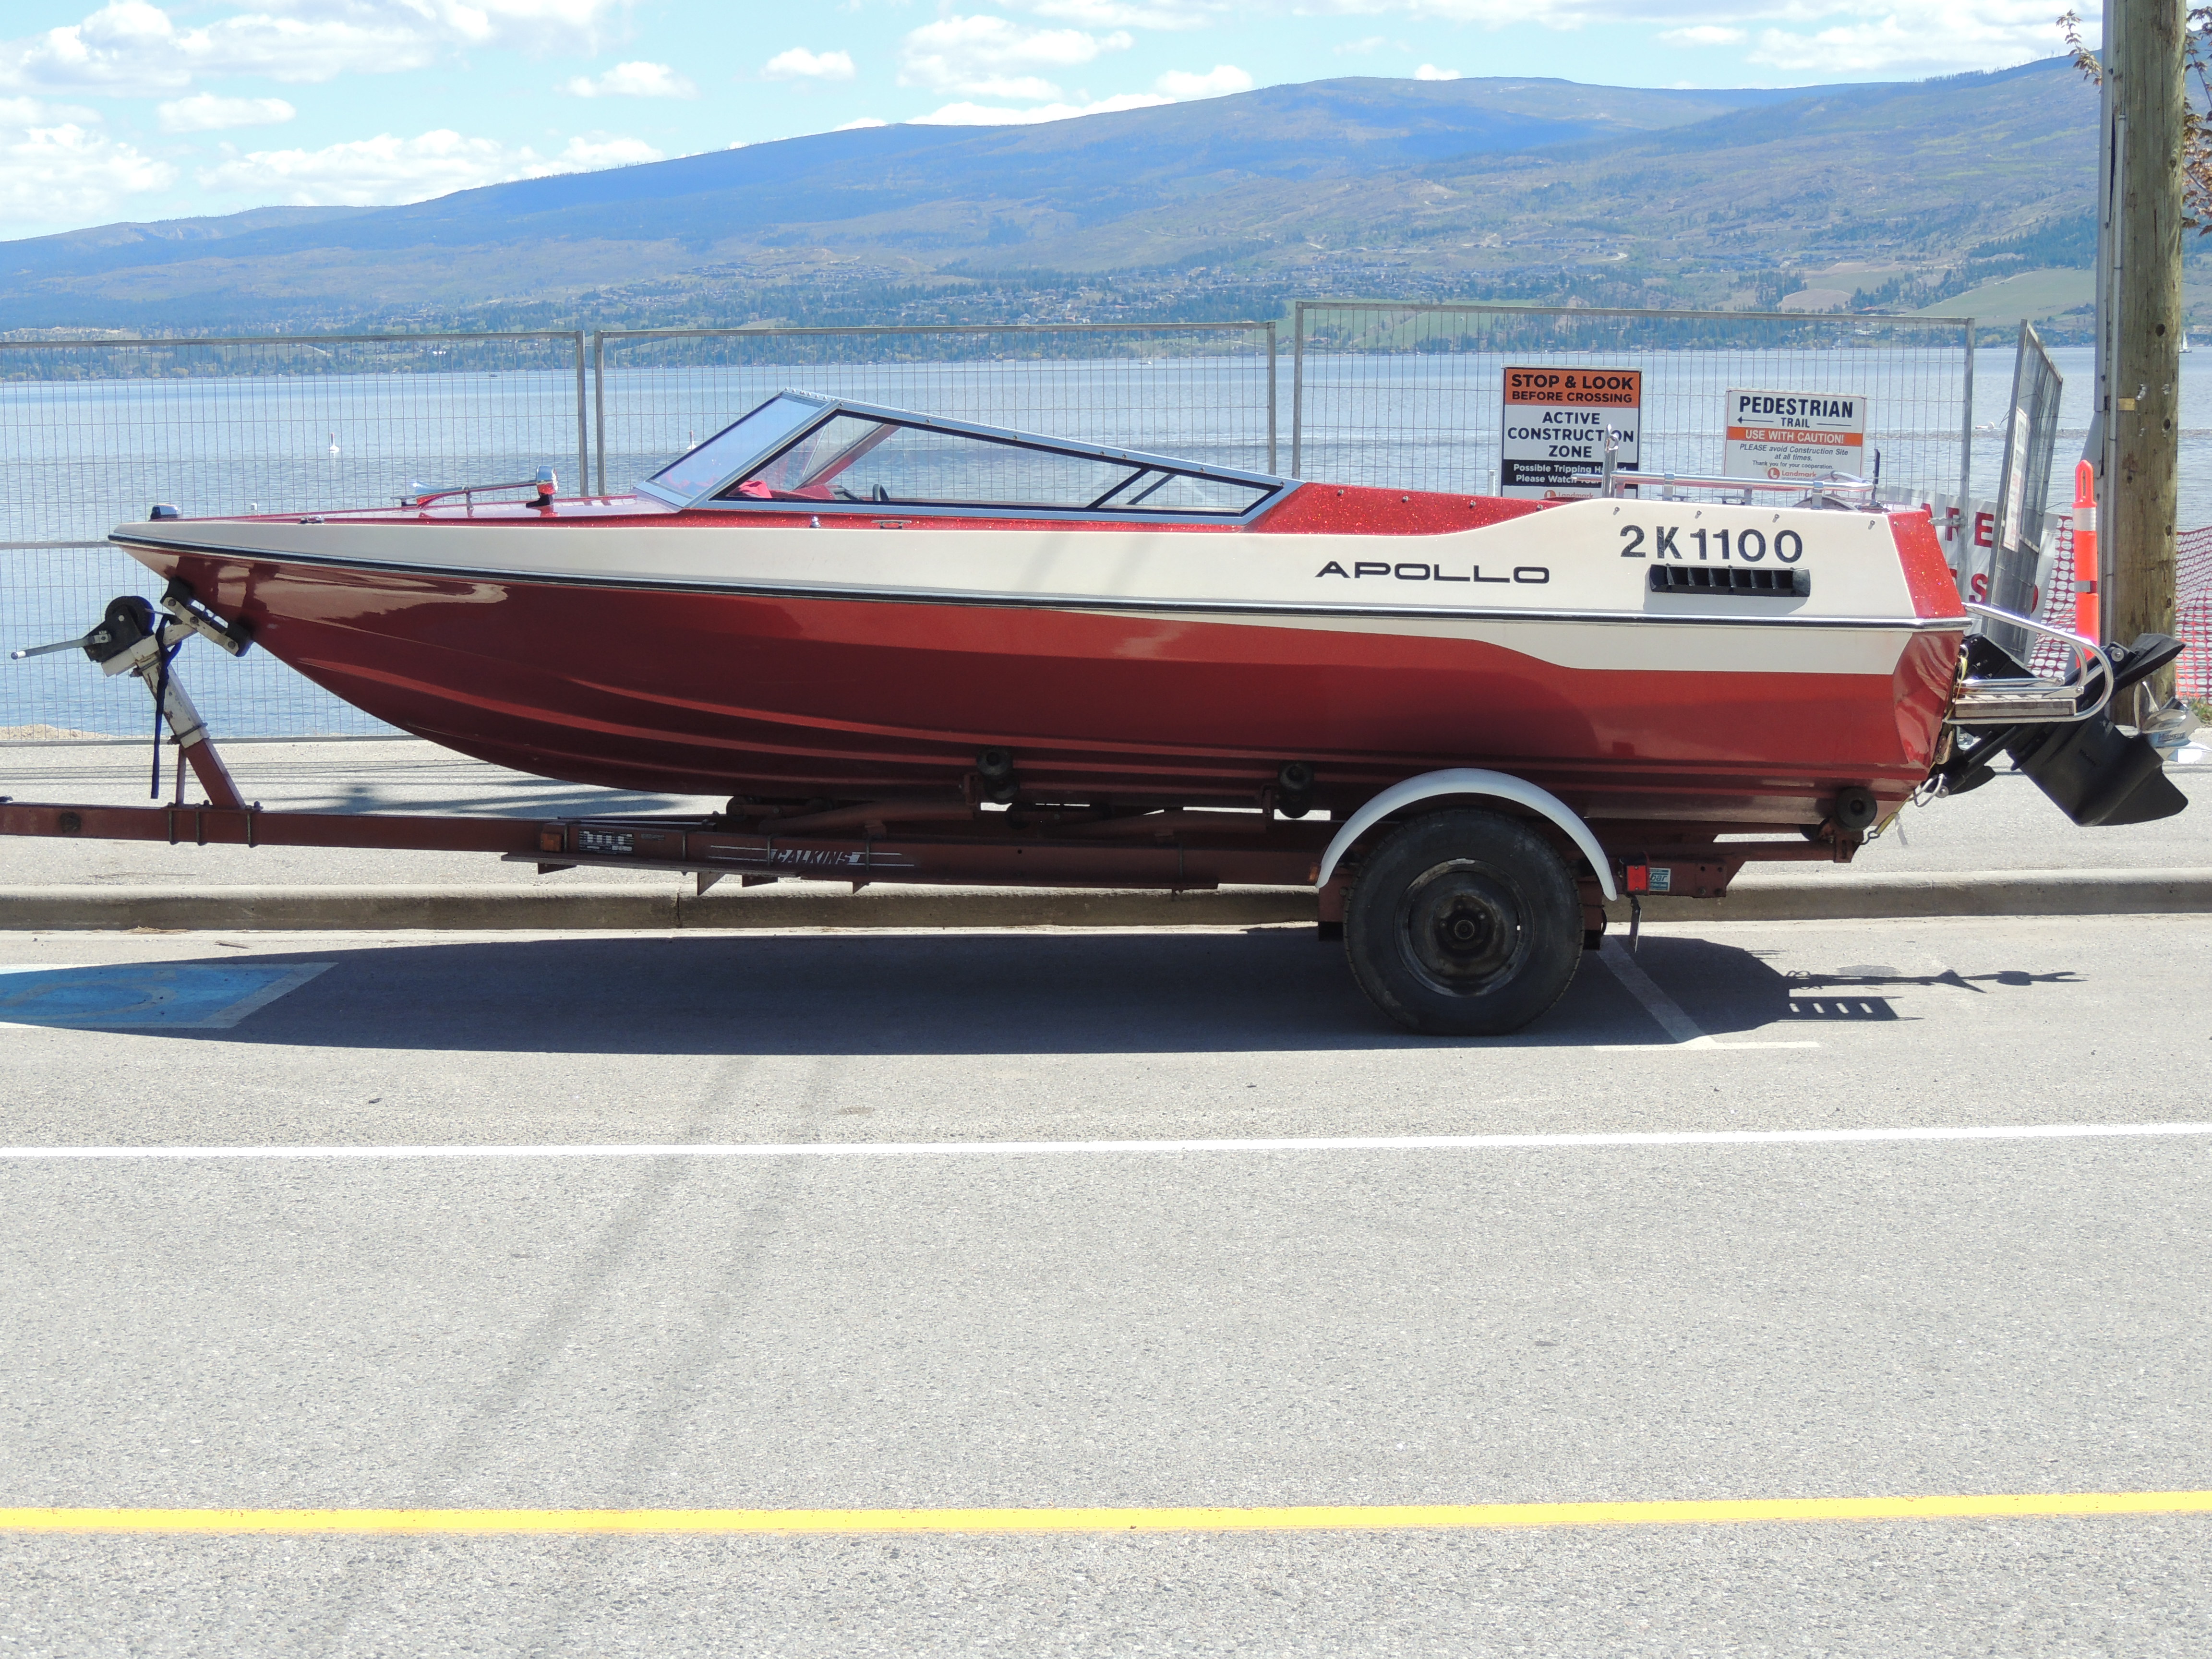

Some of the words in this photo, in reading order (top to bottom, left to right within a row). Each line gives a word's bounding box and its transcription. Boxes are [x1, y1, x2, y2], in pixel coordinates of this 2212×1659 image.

[1512, 374, 1560, 388] STOP
[1564, 375, 1576, 388] &
[1582, 376, 1634, 390] LOOK
[1512, 391, 1563, 401] BEFORE
[1566, 392, 1632, 403] CROSSING
[1739, 396, 1853, 418] PEDESTRIAN
[1542, 411, 1600, 425] ACTIVE
[1780, 417, 1810, 428] TRAIL
[1507, 427, 1634, 442] CONSTRUCTON
[1745, 430, 1765, 439] USE
[1768, 431, 1794, 441] WITH
[1797, 432, 1844, 444] CAUTION!
[1548, 445, 1592, 458] ZONE
[1739, 443, 1767, 452] PLEASE
[1790, 446, 1833, 455] Construction
[1514, 463, 1551, 472] Possible
[1553, 464, 1592, 474] Tripping
[1516, 474, 1545, 483] Please
[1620, 525, 1803, 563] 2K1100
[1314, 561, 1550, 584] APOLLO
[773, 849, 850, 865] CALKINS
